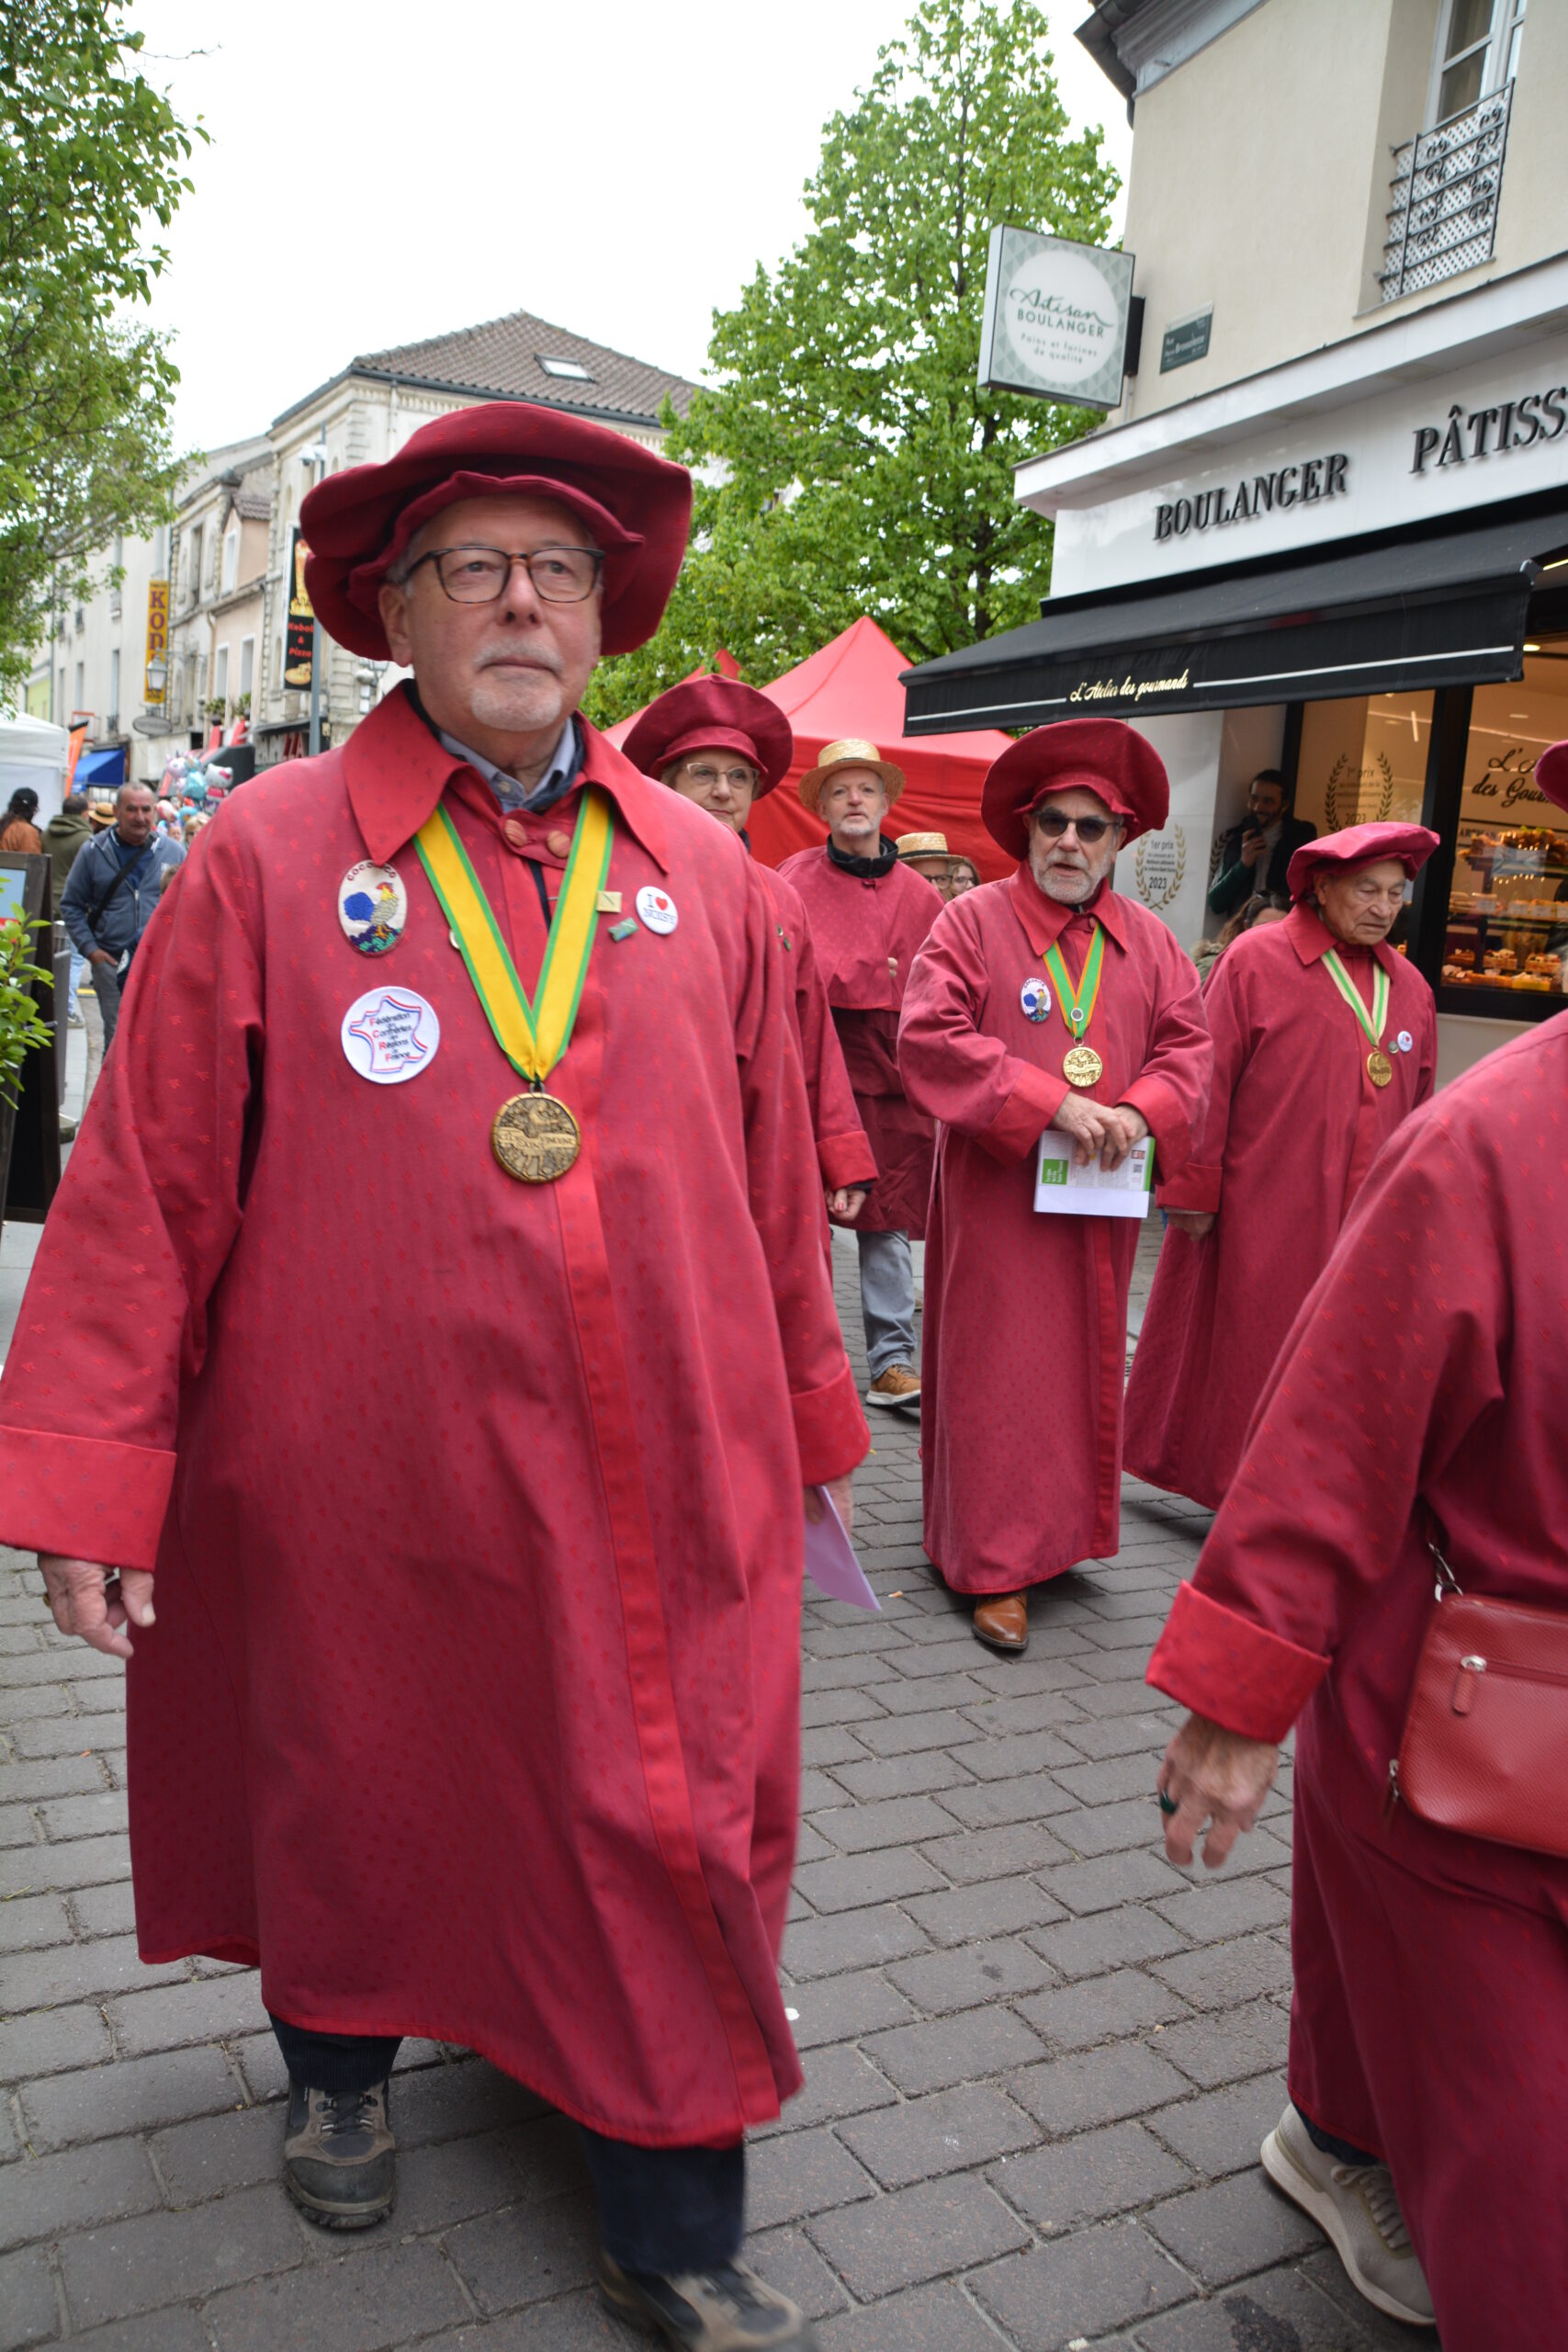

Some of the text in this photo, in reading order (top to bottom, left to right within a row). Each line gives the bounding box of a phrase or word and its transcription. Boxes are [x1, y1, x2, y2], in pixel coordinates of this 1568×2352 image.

[1010, 288, 1114, 328] Artisan
[1017, 308, 1105, 338] BOULANGER
[1021, 333, 1098, 357] Pains et farines
[1034, 346, 1045, 356] de
[1153, 453, 1349, 540] BOULANGER
[1120, 675, 1136, 695] des
[1134, 668, 1189, 702] gourmands
[1358, 765, 1374, 780] prix
[1472, 773, 1499, 797] des
[1345, 812, 1367, 826] 2023
[1162, 839, 1174, 852] prix
[1149, 876, 1168, 890] 2023
[647, 893, 654, 908] I
